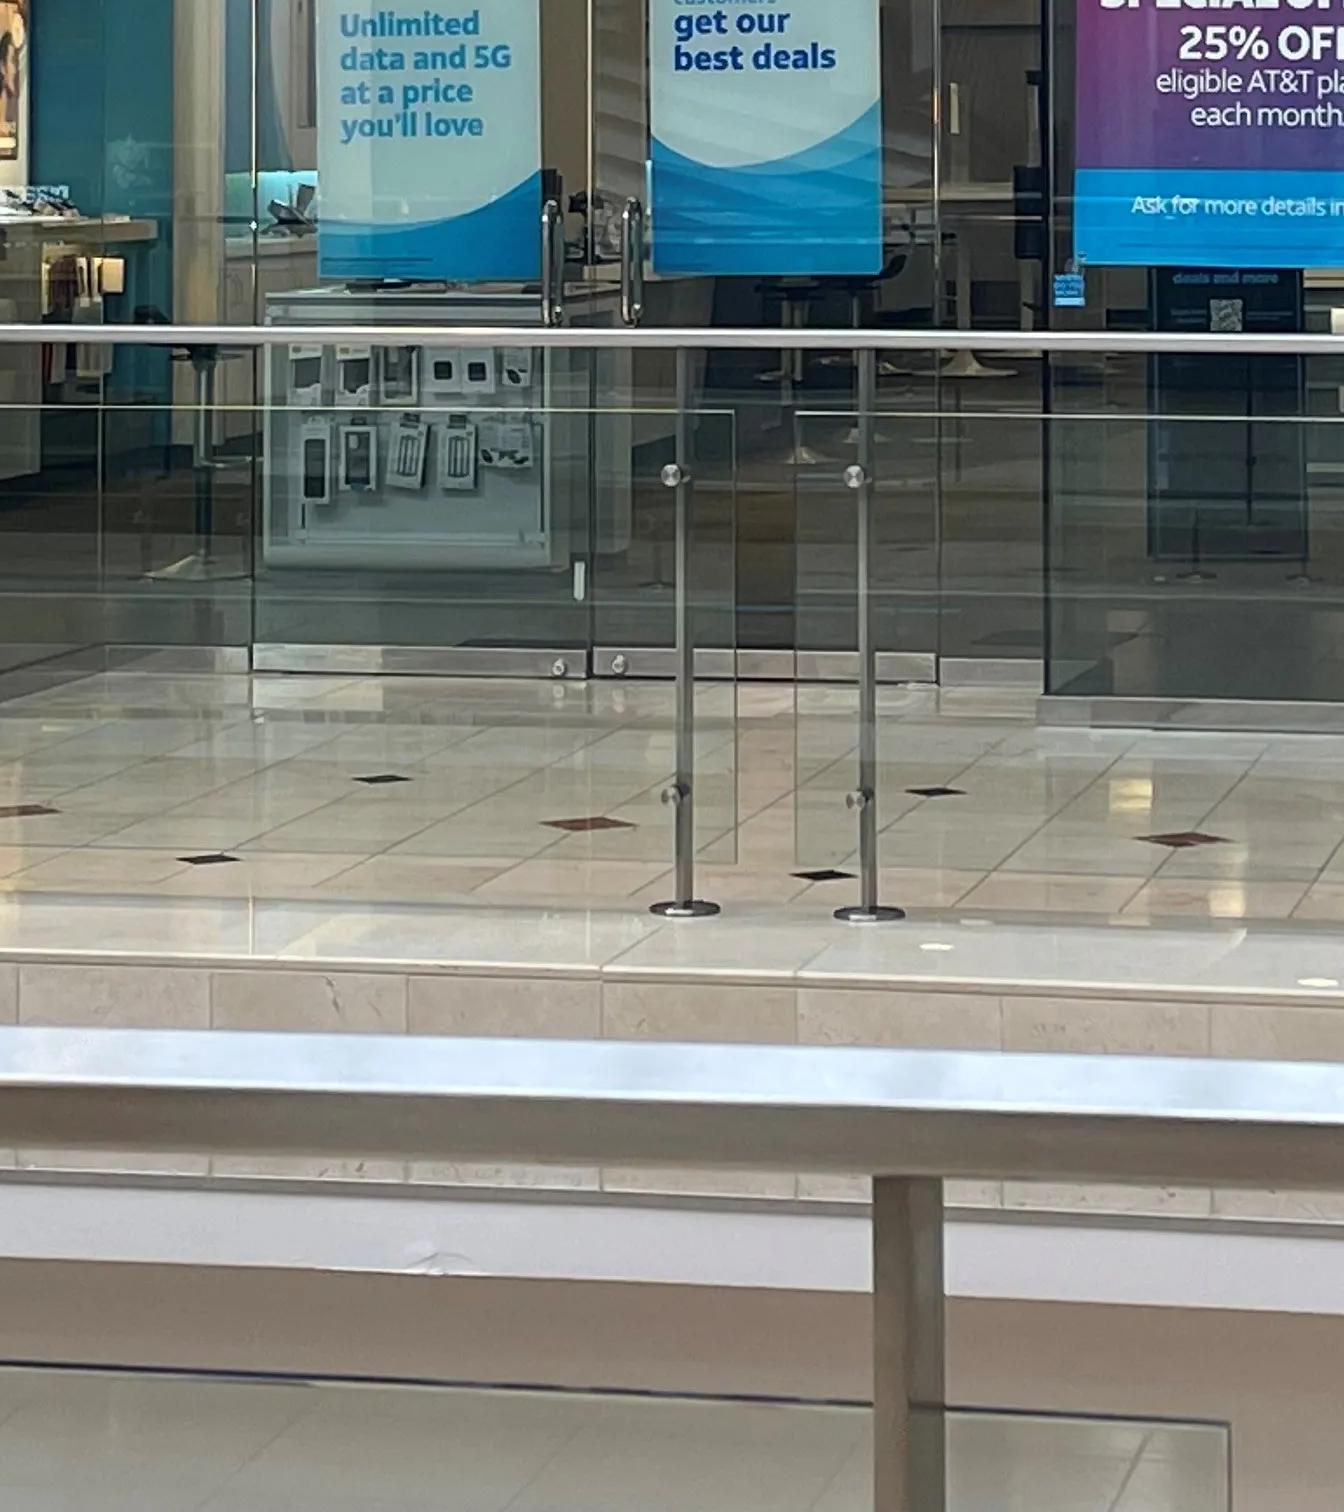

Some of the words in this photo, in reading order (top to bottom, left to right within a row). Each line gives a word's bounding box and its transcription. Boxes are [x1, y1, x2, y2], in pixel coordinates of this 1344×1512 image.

[339, 9, 480, 38] Unlimited
[674, 9, 728, 43] get
[735, 12, 792, 34] our
[340, 46, 405, 72] data
[413, 44, 467, 70] and
[474, 44, 512, 69] 5G
[674, 44, 745, 71] best
[752, 42, 837, 70] deals
[1178, 25, 1270, 61] 25%
[340, 80, 371, 105] at
[378, 85, 394, 105] a
[403, 77, 474, 109] price
[1155, 66, 1243, 100] eligible
[1247, 69, 1314, 94] AT&T
[340, 111, 417, 145] you'll
[424, 111, 484, 138] love
[1190, 101, 1252, 127] each
[1131, 195, 1166, 215] Ask
[1170, 194, 1200, 215] for
[1205, 199, 1257, 216] more
[1261, 195, 1326, 217] details
